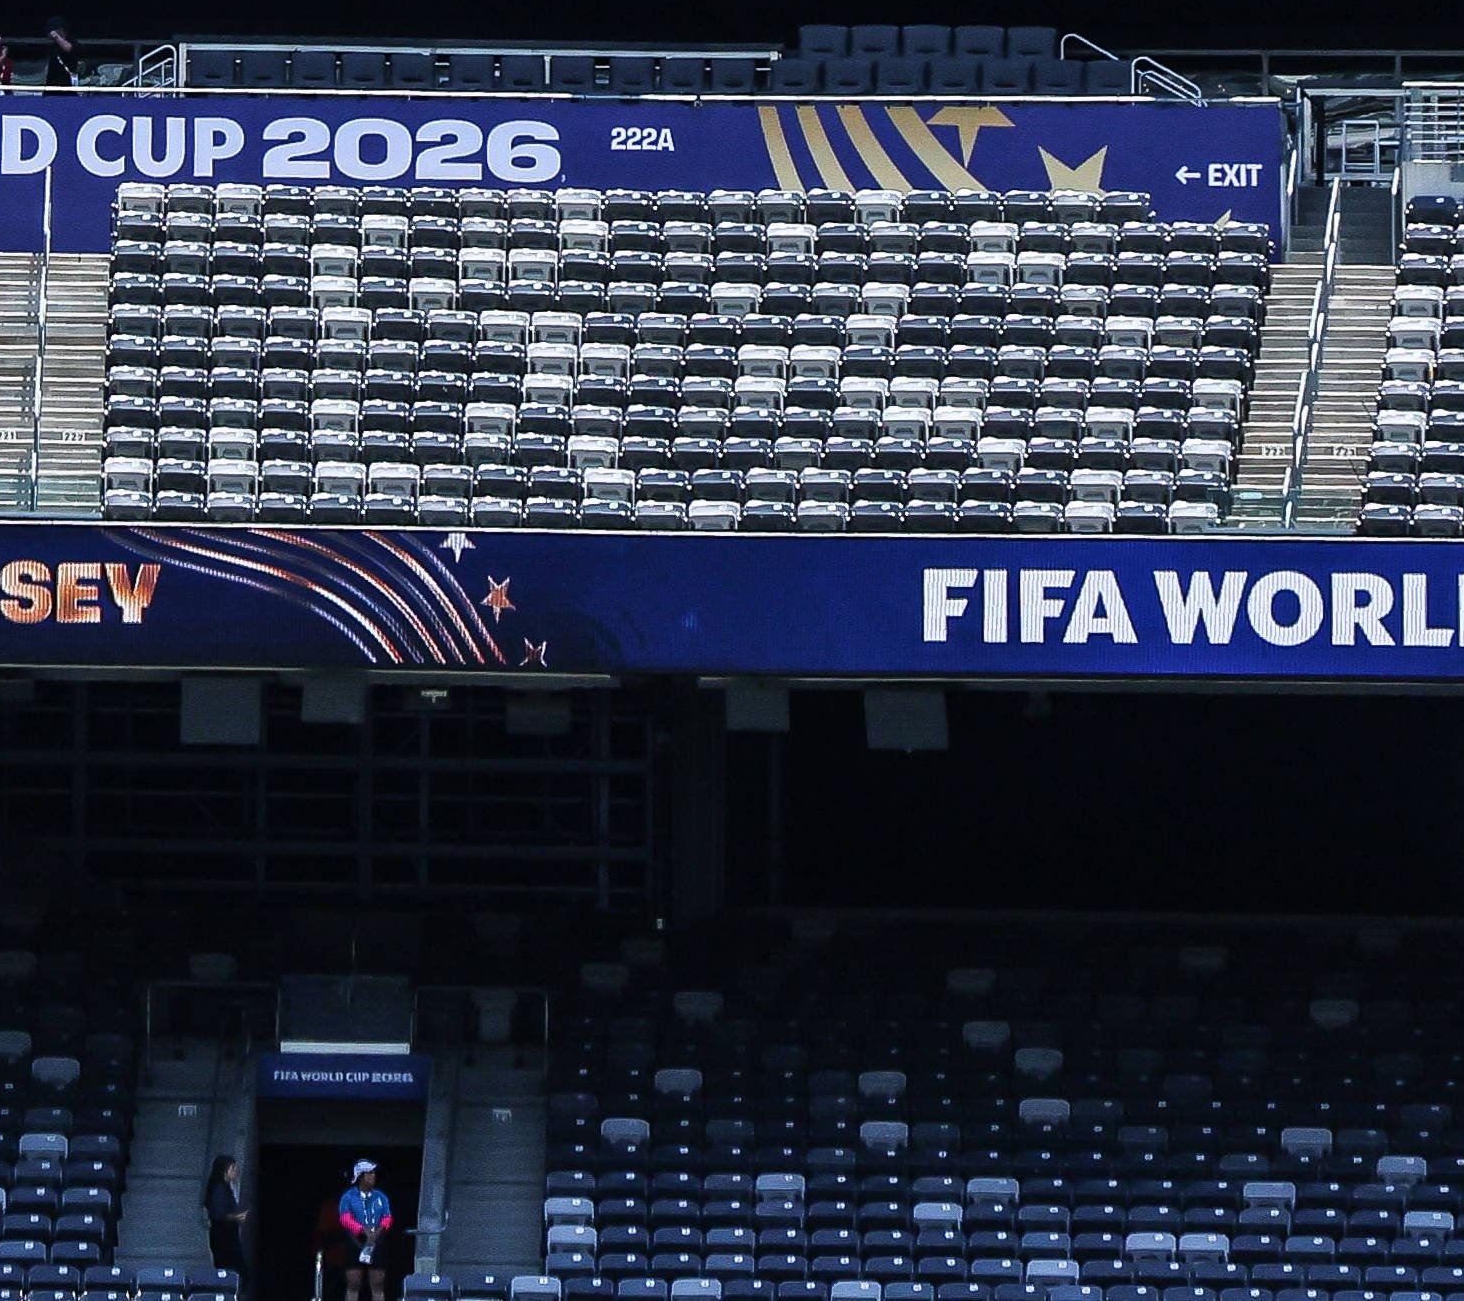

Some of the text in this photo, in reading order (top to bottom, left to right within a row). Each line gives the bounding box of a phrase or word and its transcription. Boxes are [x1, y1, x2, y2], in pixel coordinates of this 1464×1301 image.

[77, 115, 244, 179] CUP
[262, 118, 562, 182] 2026
[611, 128, 674, 151] 222A
[1208, 163, 1263, 187] EXIT
[924, 568, 1138, 643] FIFA
[301, 1071, 344, 1082] WORLD
